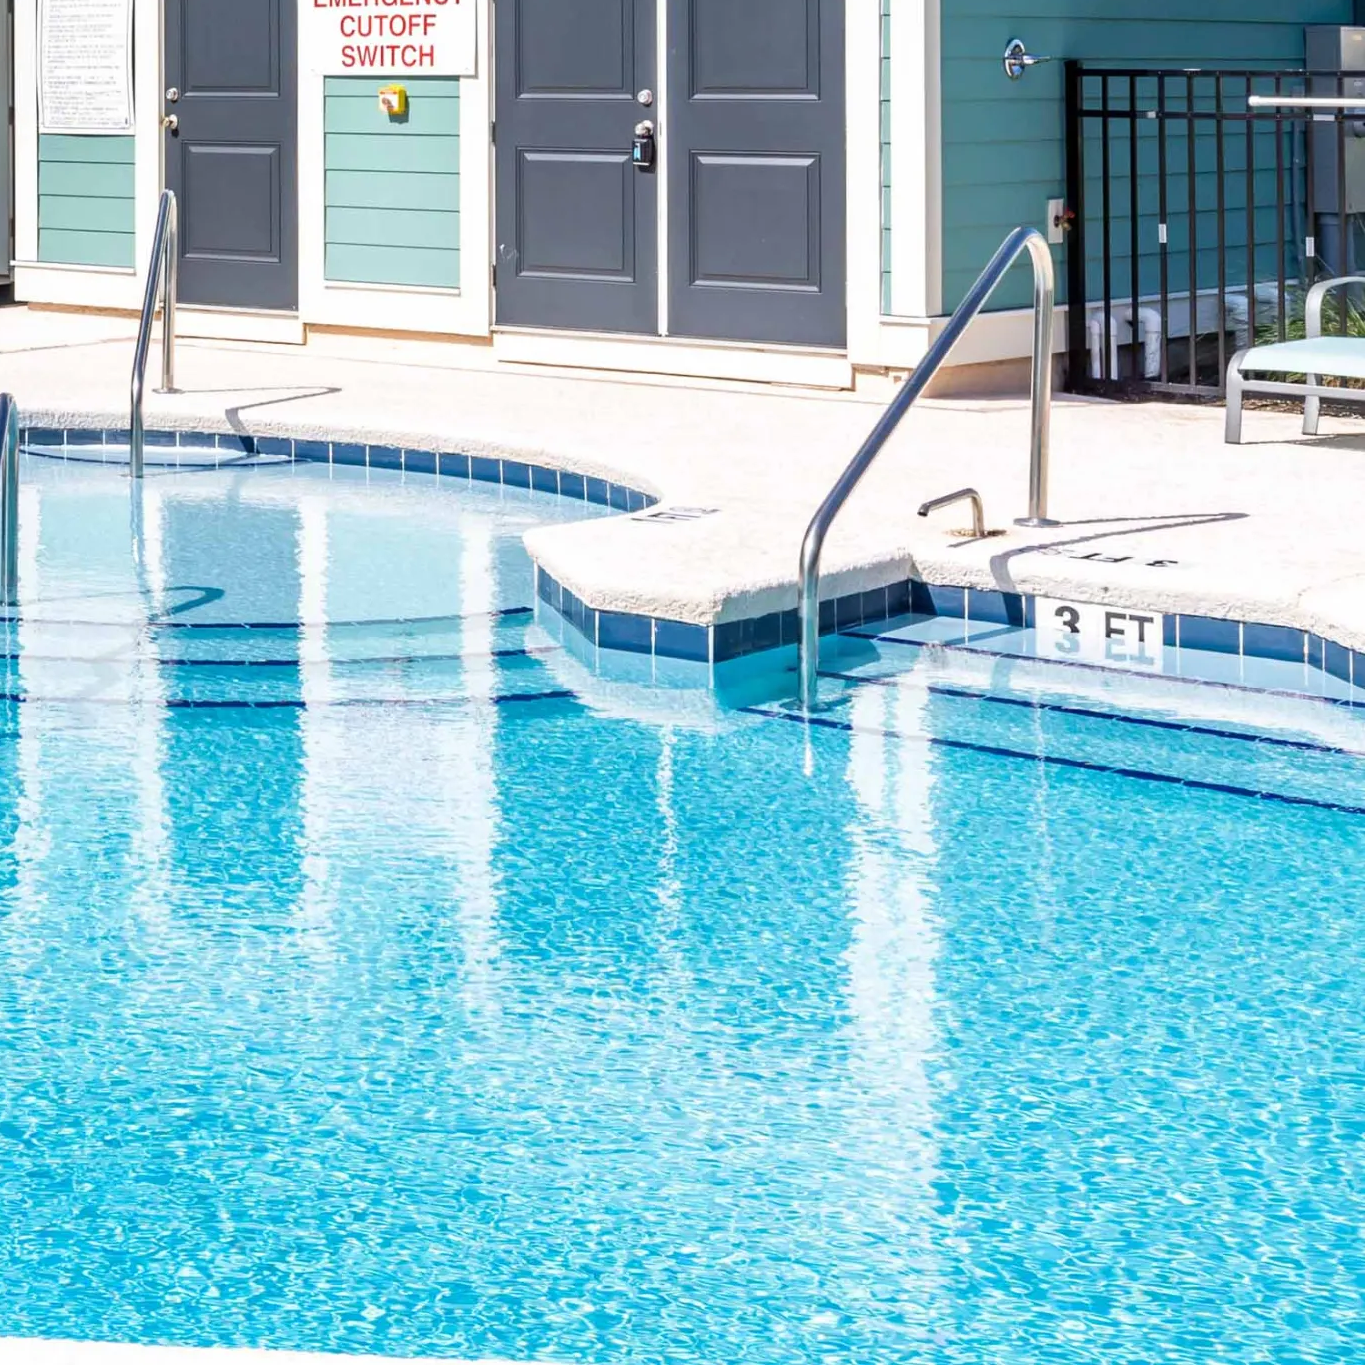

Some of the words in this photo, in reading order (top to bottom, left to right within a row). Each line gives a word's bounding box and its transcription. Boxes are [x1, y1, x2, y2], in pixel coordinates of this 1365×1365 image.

[340, 14, 437, 37] CUTOFF
[341, 44, 435, 67] SWITCH
[1054, 606, 1080, 634] 3
[1105, 611, 1155, 643] FT
